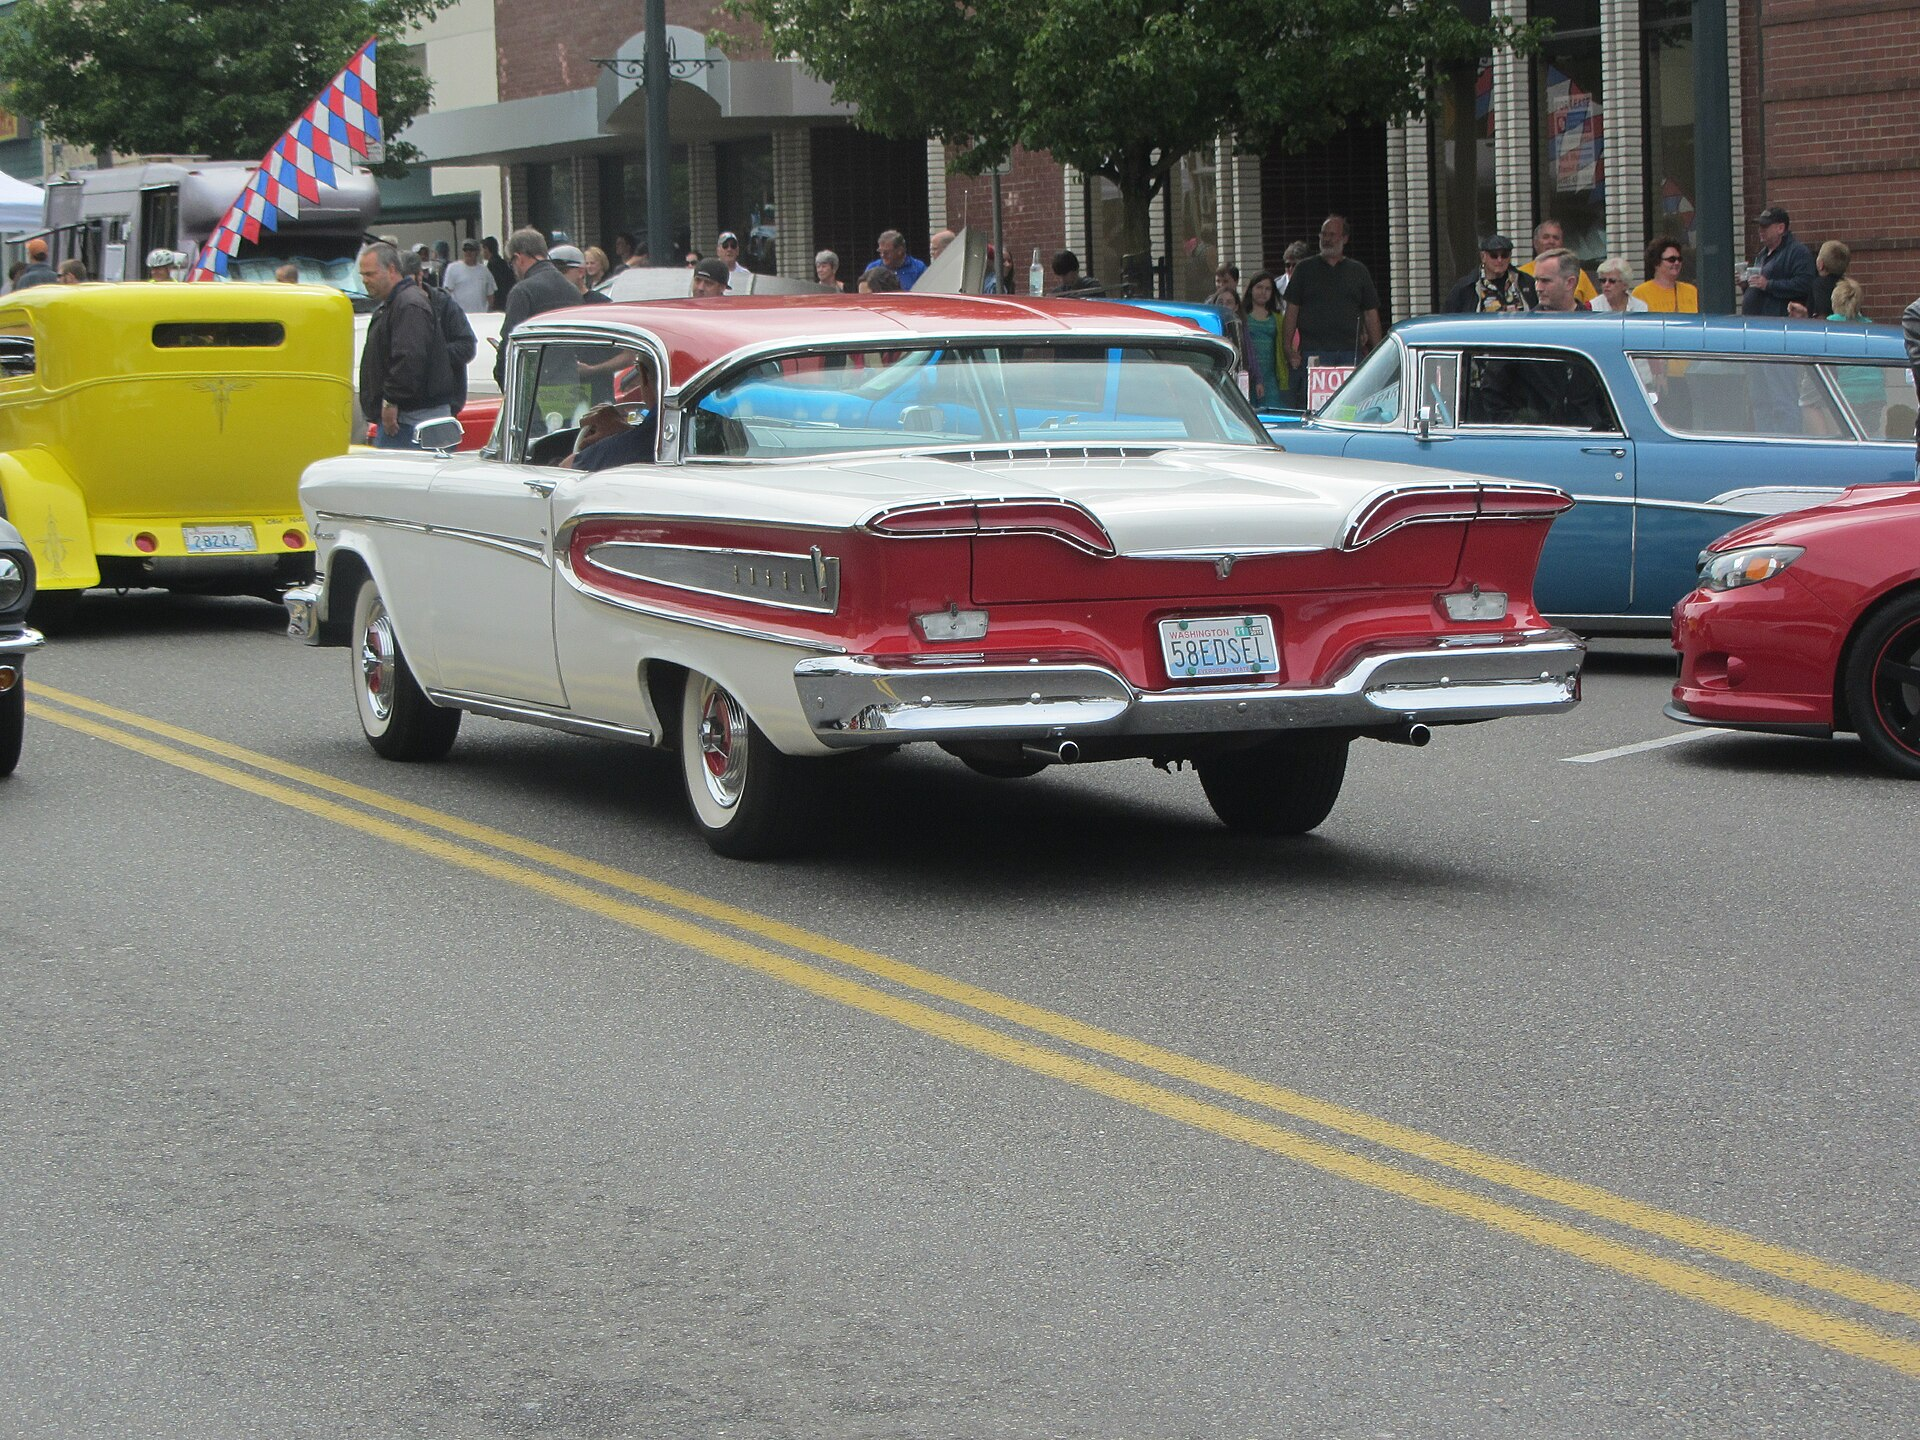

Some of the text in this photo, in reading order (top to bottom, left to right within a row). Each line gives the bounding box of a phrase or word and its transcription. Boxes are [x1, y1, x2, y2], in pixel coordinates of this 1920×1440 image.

[1312, 371, 1342, 391] NO
[970, 447, 1126, 461] EDSEL
[193, 535, 239, 547] 28242
[1169, 628, 1230, 639] WASHINGTON
[1171, 637, 1269, 667] 58EDSEL
